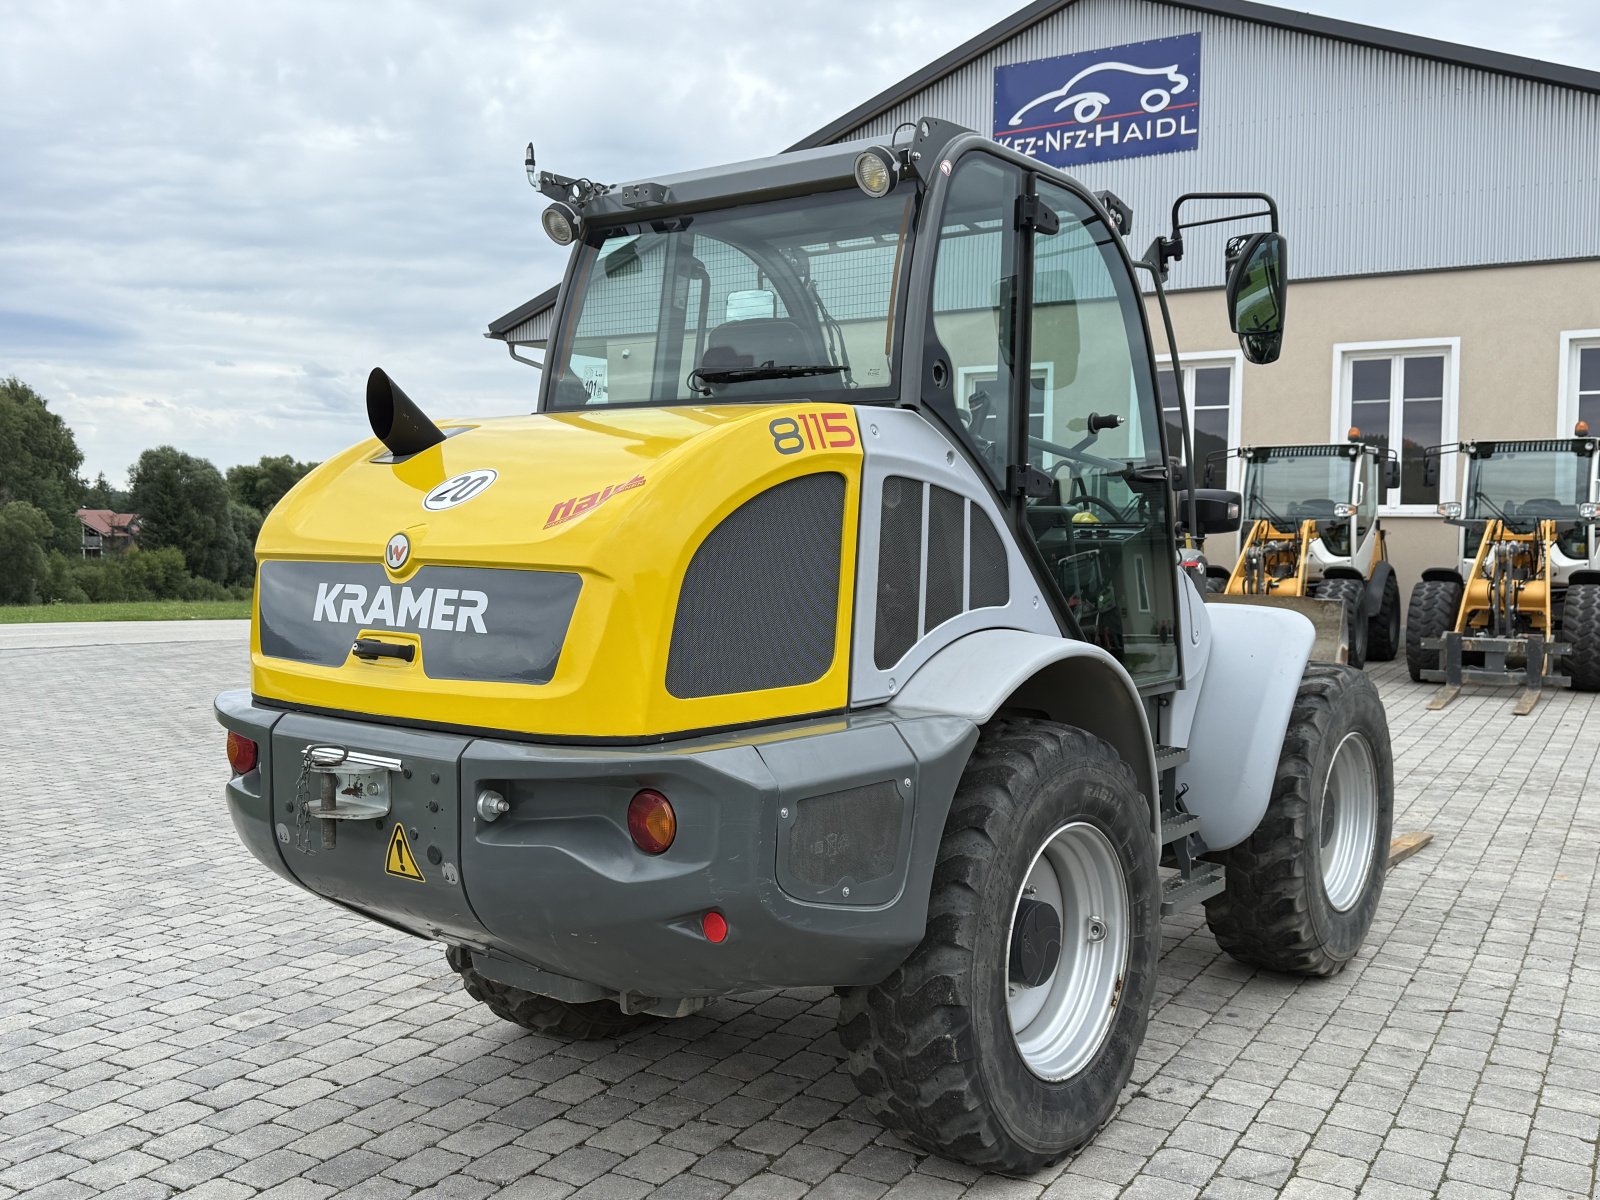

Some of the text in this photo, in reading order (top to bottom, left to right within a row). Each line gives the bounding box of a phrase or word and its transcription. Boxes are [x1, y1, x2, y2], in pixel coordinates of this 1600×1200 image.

[768, 412, 856, 456] 8115
[429, 475, 489, 503] 20
[312, 582, 489, 634] KRAMER
